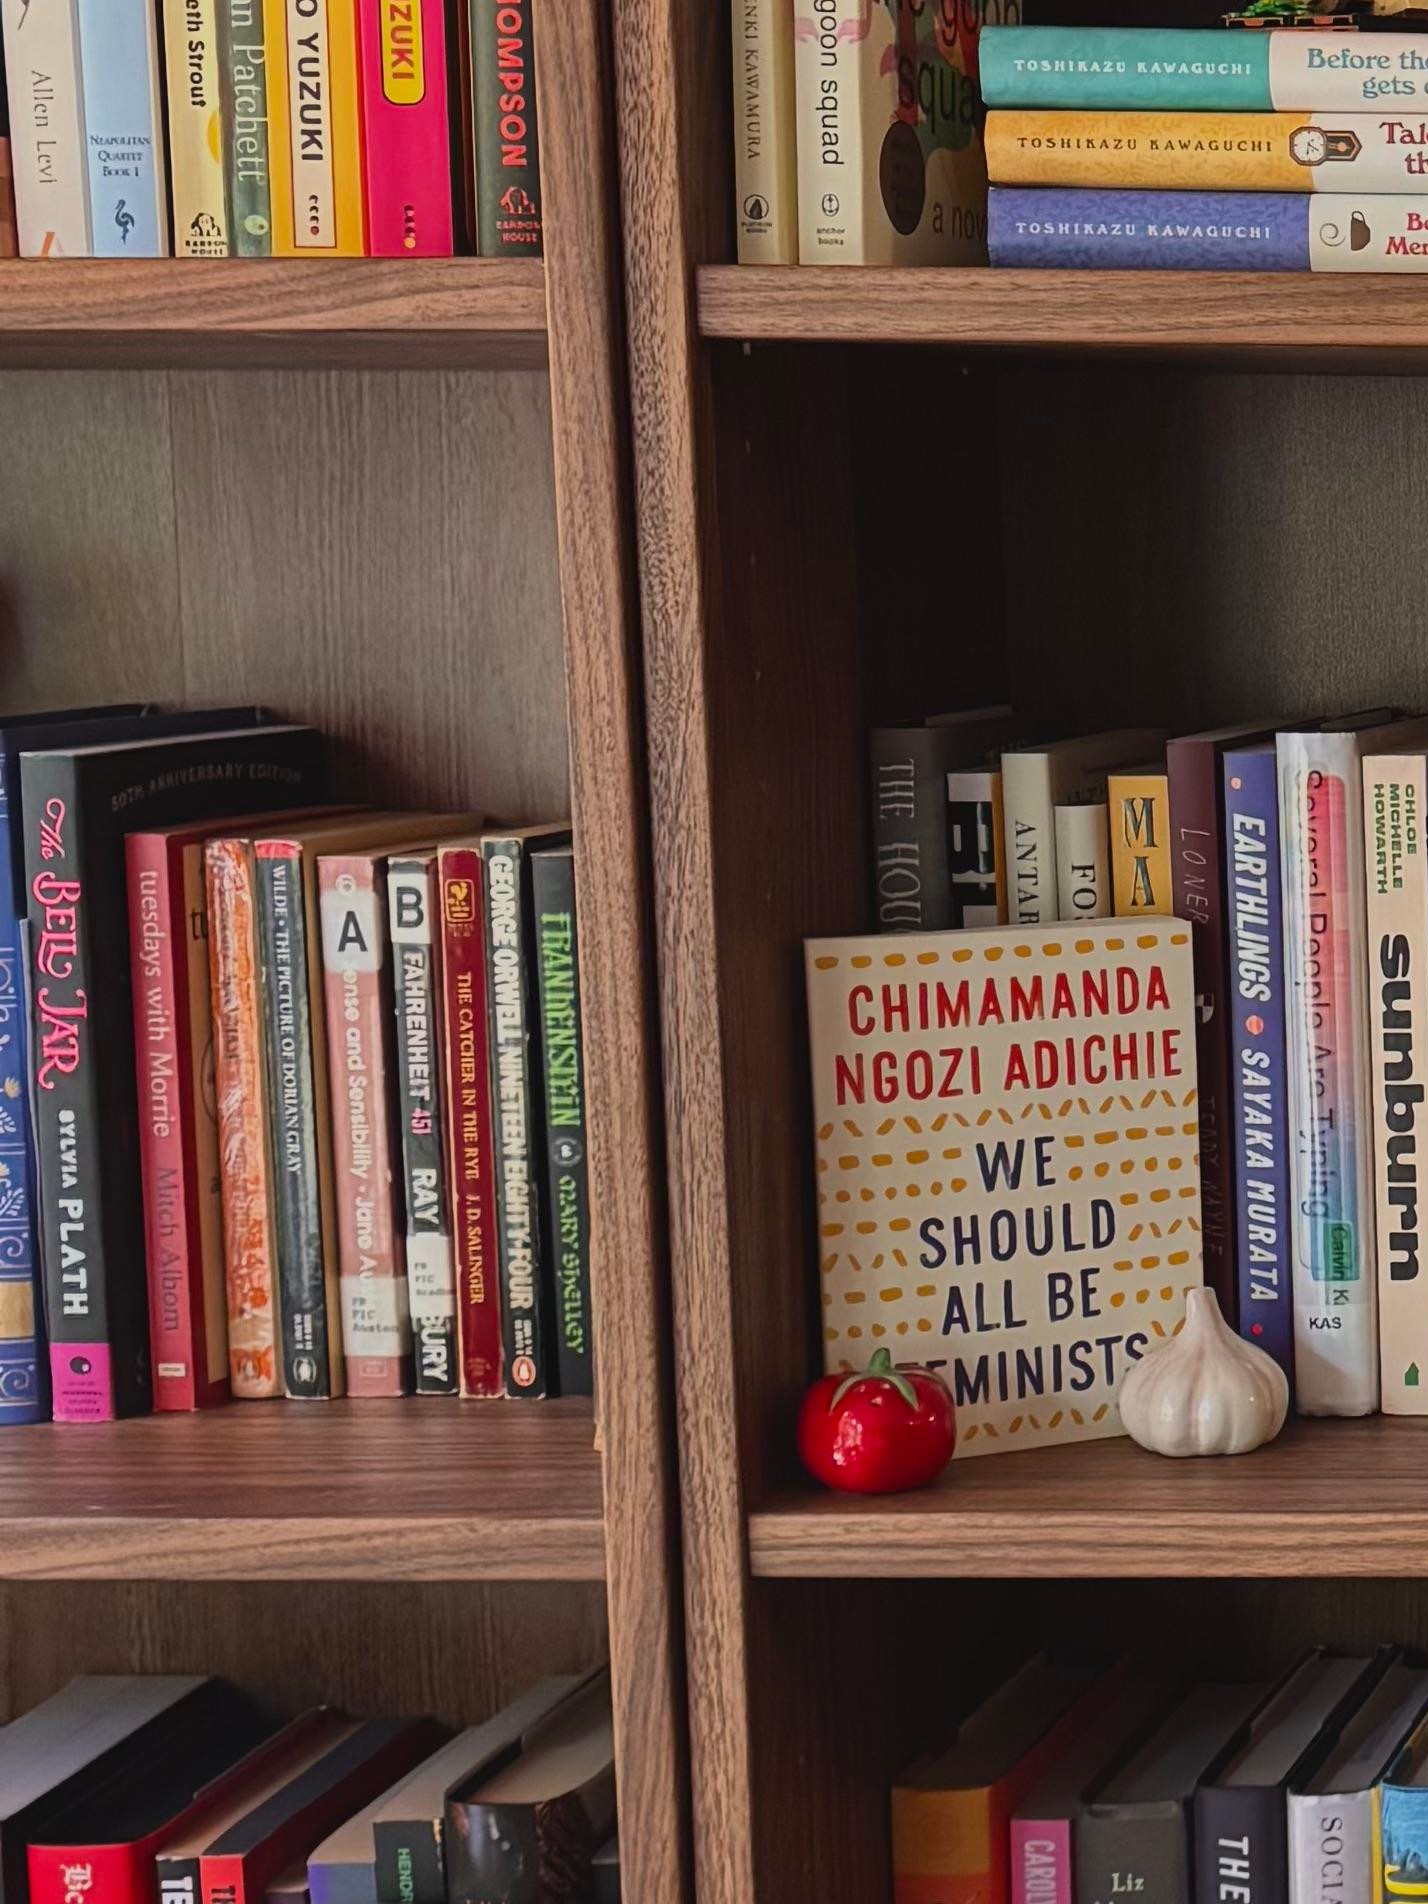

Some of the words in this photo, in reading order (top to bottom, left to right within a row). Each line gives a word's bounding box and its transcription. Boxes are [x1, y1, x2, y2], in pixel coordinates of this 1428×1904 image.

[814, 0, 838, 66] goon
[1014, 58, 1128, 75] TOSHIKAZU
[1137, 60, 1252, 76] KAWAGUCHI
[1307, 48, 1389, 74] Before
[294, 31, 325, 162] YUZUKI
[814, 77, 845, 165] squad
[1362, 76, 1408, 98] gets
[1231, 814, 1271, 1002] EARTHLINGS
[847, 966, 1171, 1036] CHIMAMANDA
[834, 1047, 982, 1105] NGOZI
[1004, 1029, 1182, 1090] ADICHIE
[1380, 934, 1425, 1281] sunburn
[59, 1110, 73, 1188] SYLVIA
[975, 1136, 1057, 1192] WE
[58, 1198, 89, 1316] PLATH
[919, 1198, 1117, 1268] SHOULD
[941, 1282, 1027, 1337] ALL
[1048, 1268, 1102, 1323] BE
